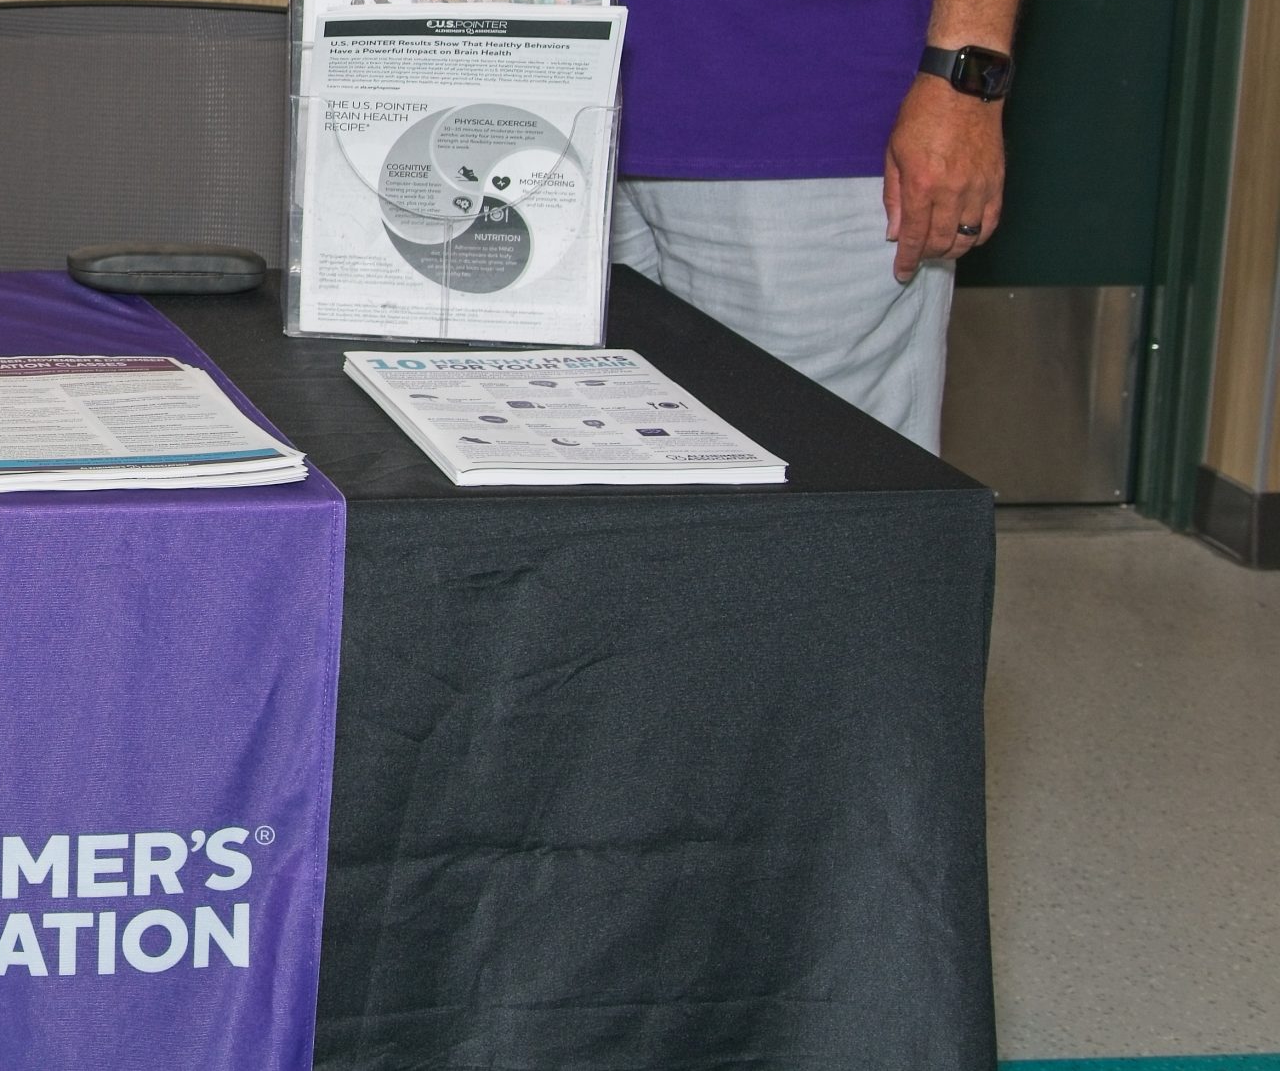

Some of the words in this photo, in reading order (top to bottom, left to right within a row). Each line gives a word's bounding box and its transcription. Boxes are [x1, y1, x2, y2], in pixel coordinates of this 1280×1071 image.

[351, 39, 396, 47] POINTER
[398, 39, 432, 47] Results
[485, 41, 522, 49] Healthy
[524, 41, 570, 49] Behaviors
[330, 47, 352, 55] Have
[362, 47, 404, 55] Powerful
[406, 47, 438, 56] Impact
[481, 49, 512, 57] Health
[327, 100, 349, 109] THE
[352, 101, 371, 110] U.S.
[375, 102, 428, 112] POINTER
[325, 111, 360, 121] BRAIN
[363, 113, 409, 122] HEALTH
[454, 118, 495, 127] PHYSICAL
[496, 119, 538, 127] EXERCISE
[386, 163, 432, 172] COGNITIVE
[388, 171, 429, 179] EXERCISE
[532, 172, 564, 180] HEALTH
[474, 233, 521, 242] NUTRITION
[366, 359, 426, 370] 10
[542, 355, 628, 363] HABITS
[489, 363, 560, 371] YOUR
[565, 361, 638, 369] BRAIN
